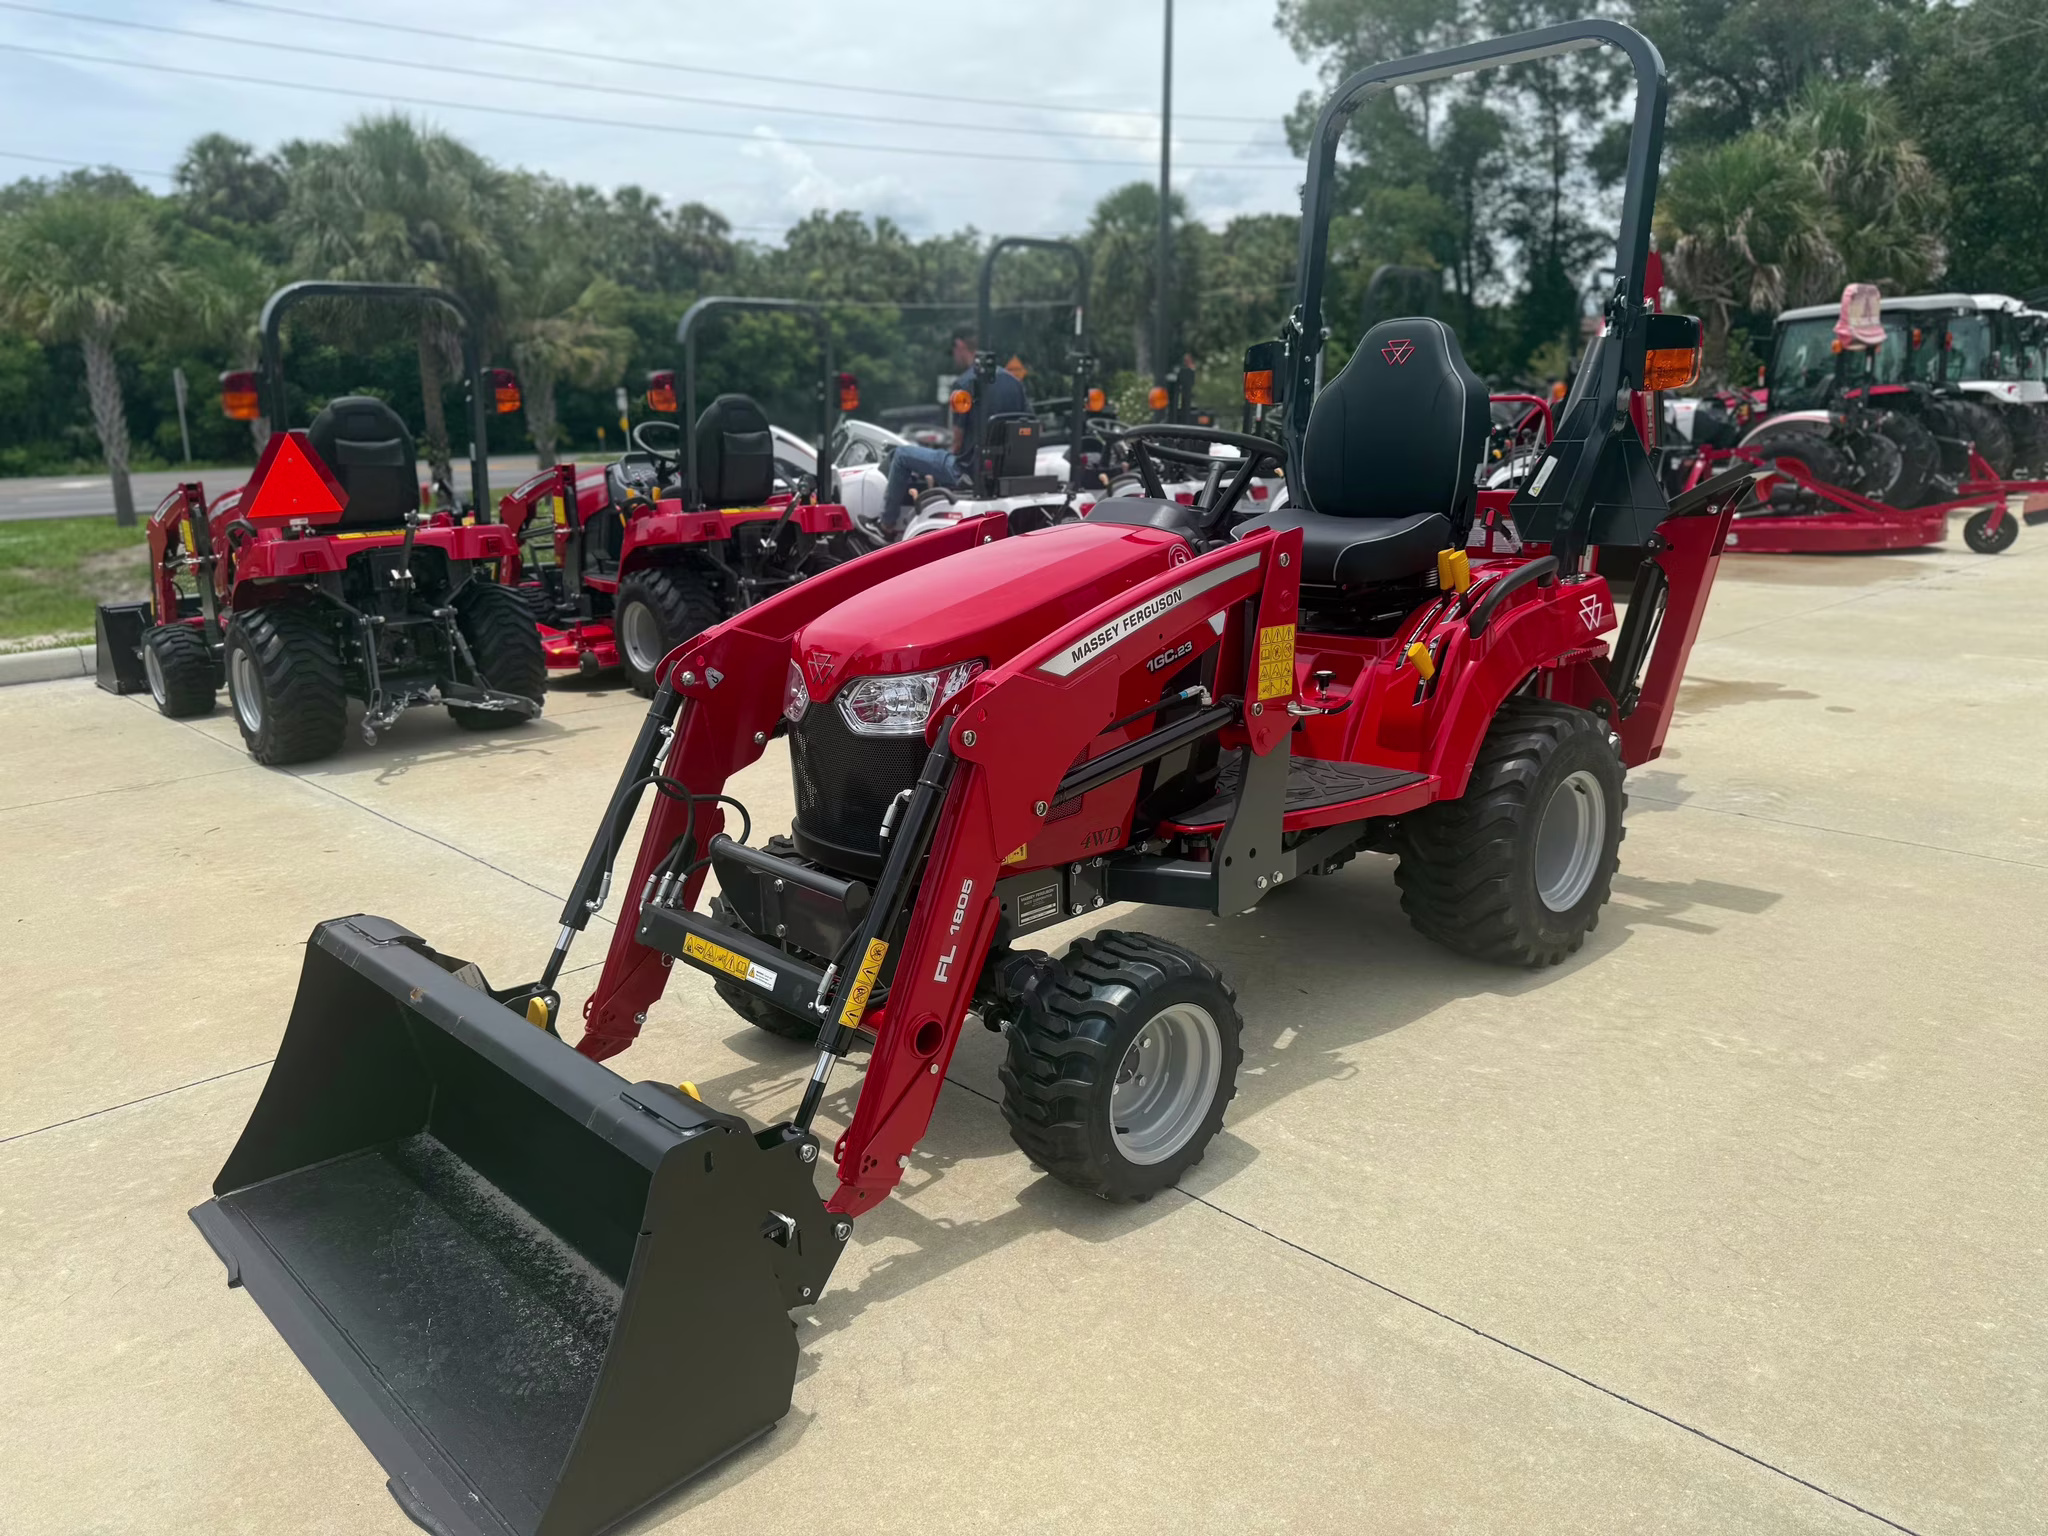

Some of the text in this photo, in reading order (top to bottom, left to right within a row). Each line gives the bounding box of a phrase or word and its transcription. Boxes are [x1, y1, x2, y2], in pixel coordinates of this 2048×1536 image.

[1071, 588, 1182, 663] MASSEY FERGUSON
[1146, 641, 1193, 672] 1GC.23
[1080, 827, 1121, 849] 4WD
[933, 878, 973, 983] FL 1805
